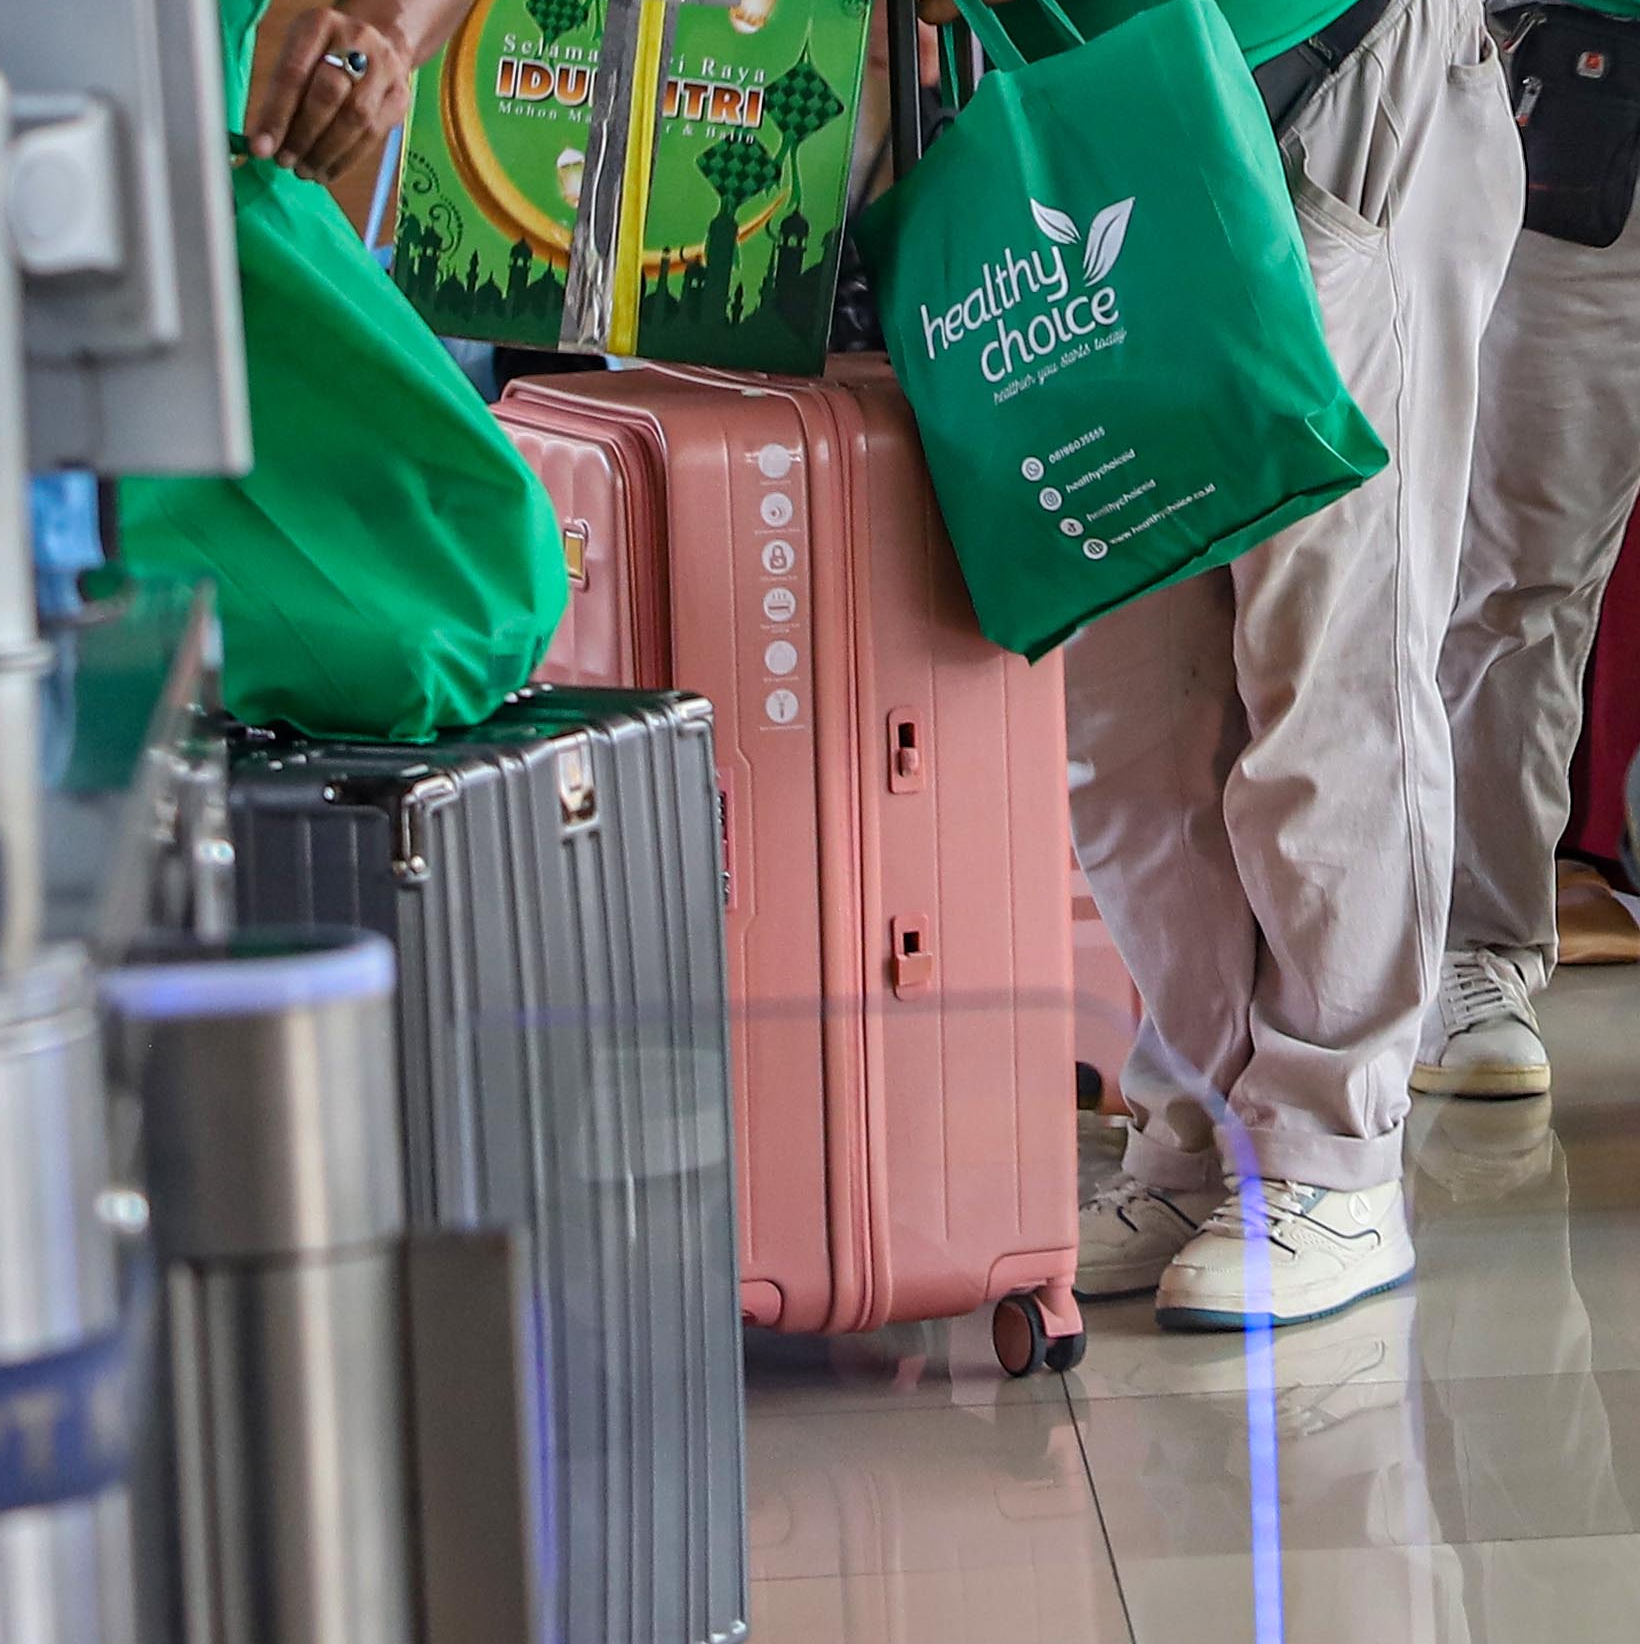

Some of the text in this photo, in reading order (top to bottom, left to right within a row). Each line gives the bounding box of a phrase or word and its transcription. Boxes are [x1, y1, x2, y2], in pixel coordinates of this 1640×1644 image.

[503, 32, 599, 62] Selama
[701, 57, 765, 85] Raya
[495, 55, 765, 128] IDU ITRI
[498, 100, 558, 121] Mohon
[920, 245, 1069, 360] healthy
[980, 286, 1119, 383] choice
[1037, 362, 1059, 386] you
